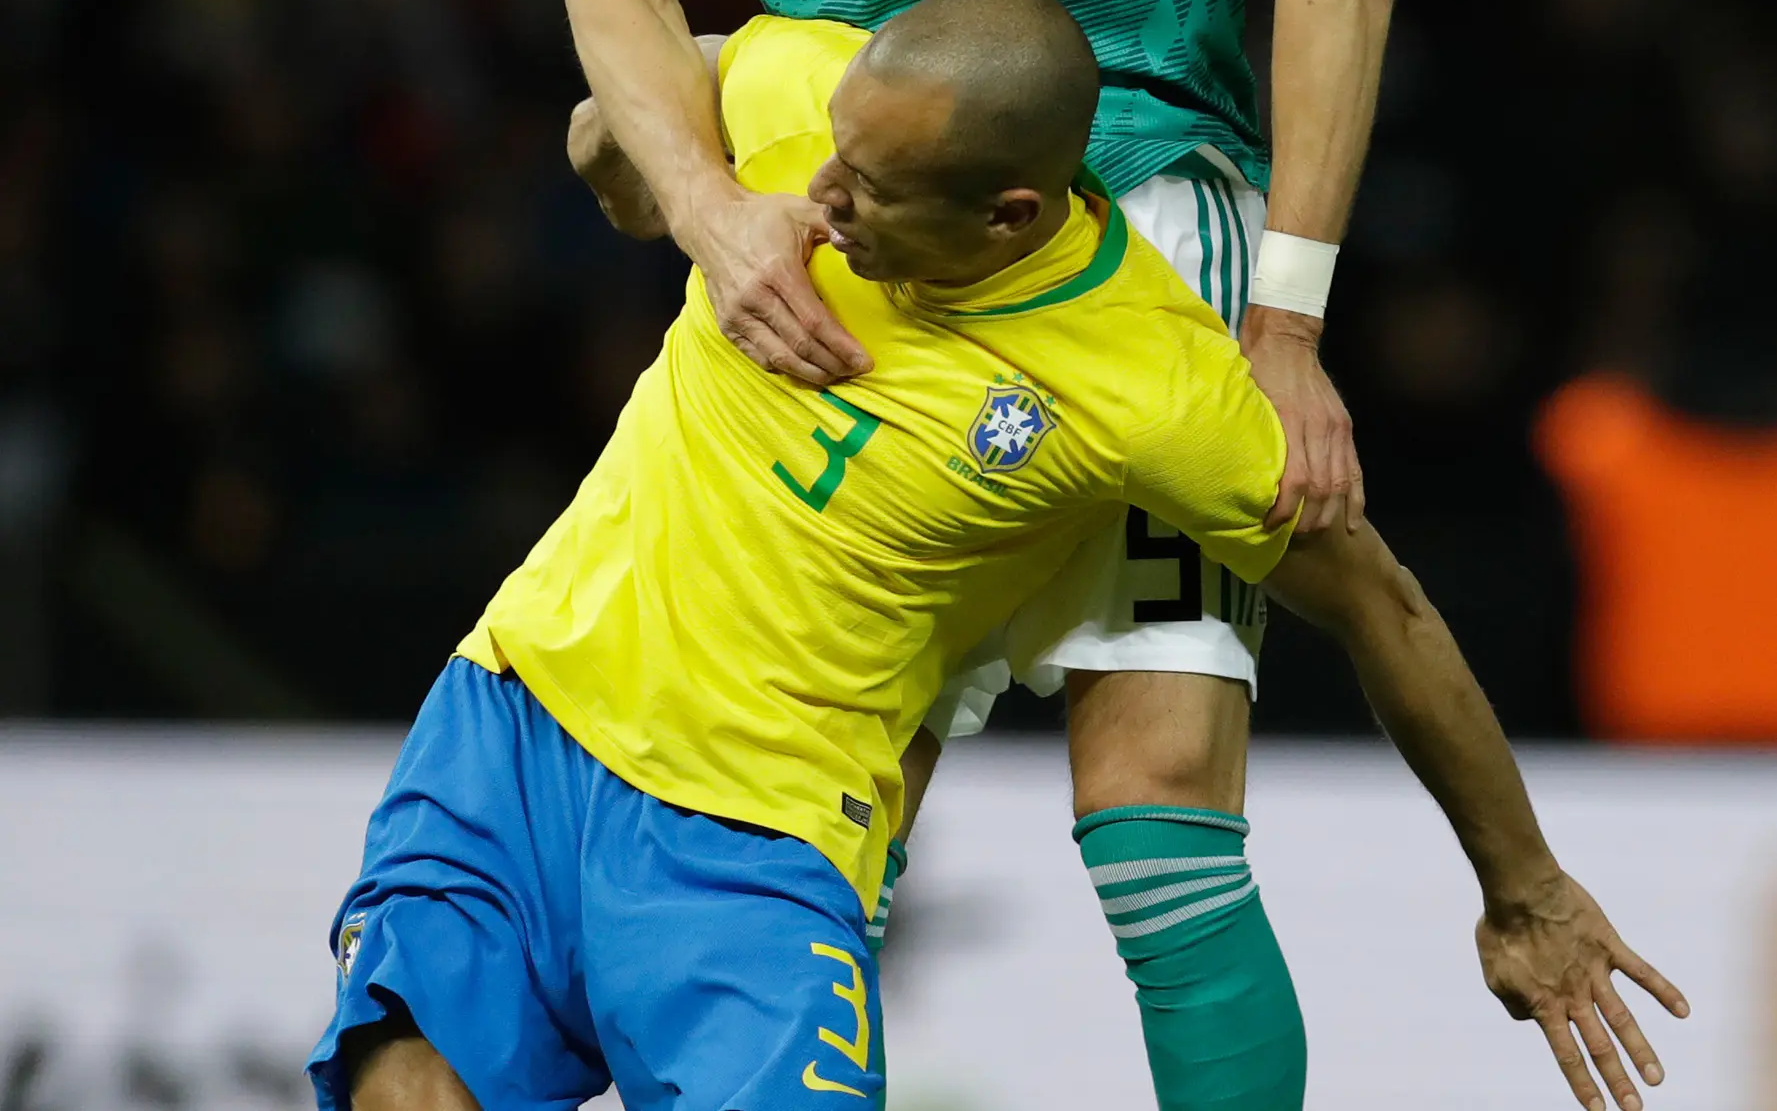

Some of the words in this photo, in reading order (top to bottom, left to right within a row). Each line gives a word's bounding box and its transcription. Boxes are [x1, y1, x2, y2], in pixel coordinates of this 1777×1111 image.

[771, 387, 881, 514] 3
[997, 420, 1022, 437] CBF
[810, 942, 869, 1072] 3
